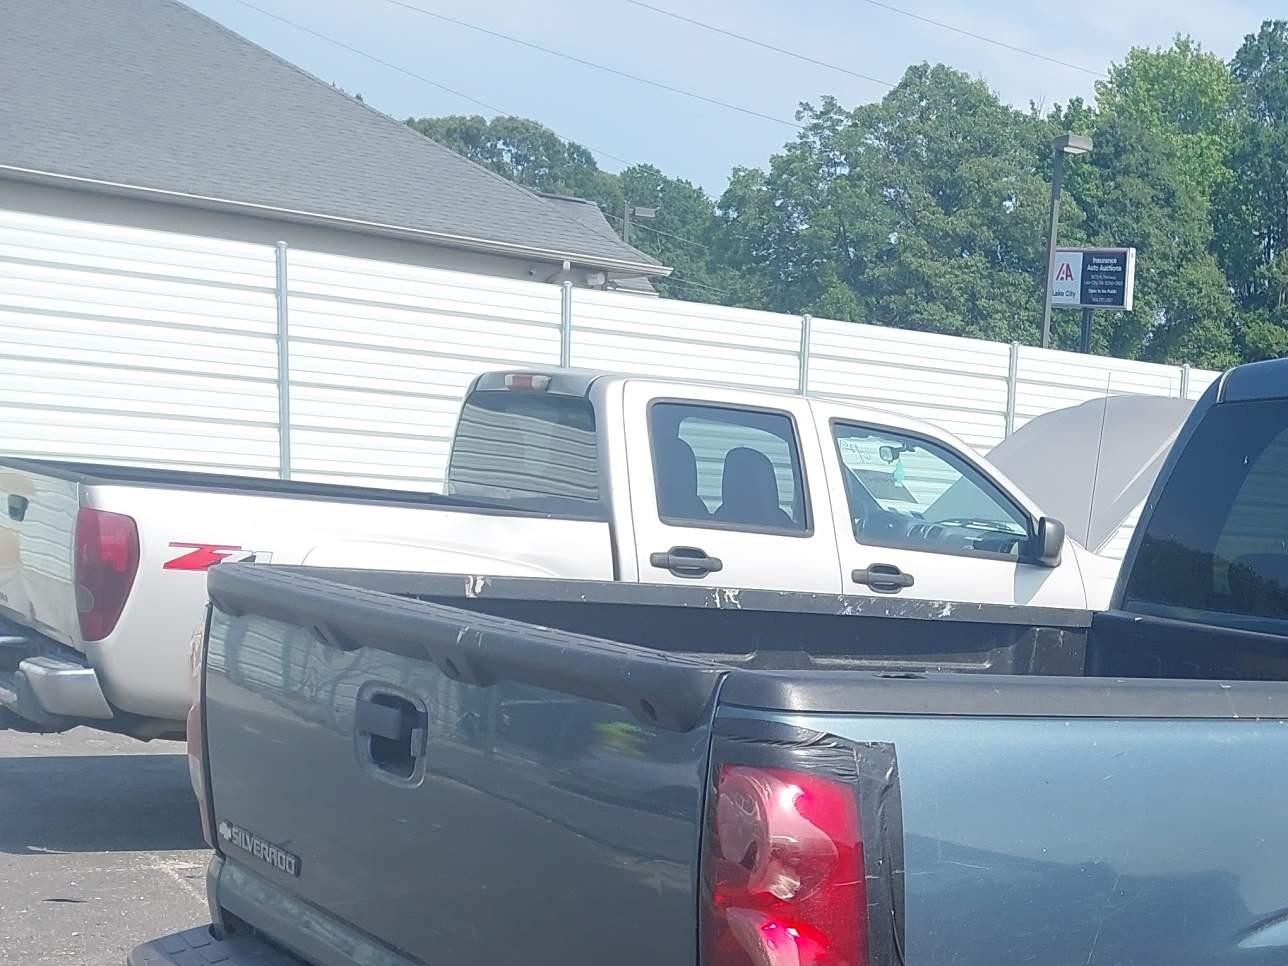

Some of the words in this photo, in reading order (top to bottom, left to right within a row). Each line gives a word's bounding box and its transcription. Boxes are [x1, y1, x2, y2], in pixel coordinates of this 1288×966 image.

[1100, 264, 1122, 272] Auctions
[1065, 290, 1076, 299] City
[231, 826, 297, 875] SILVERADO
